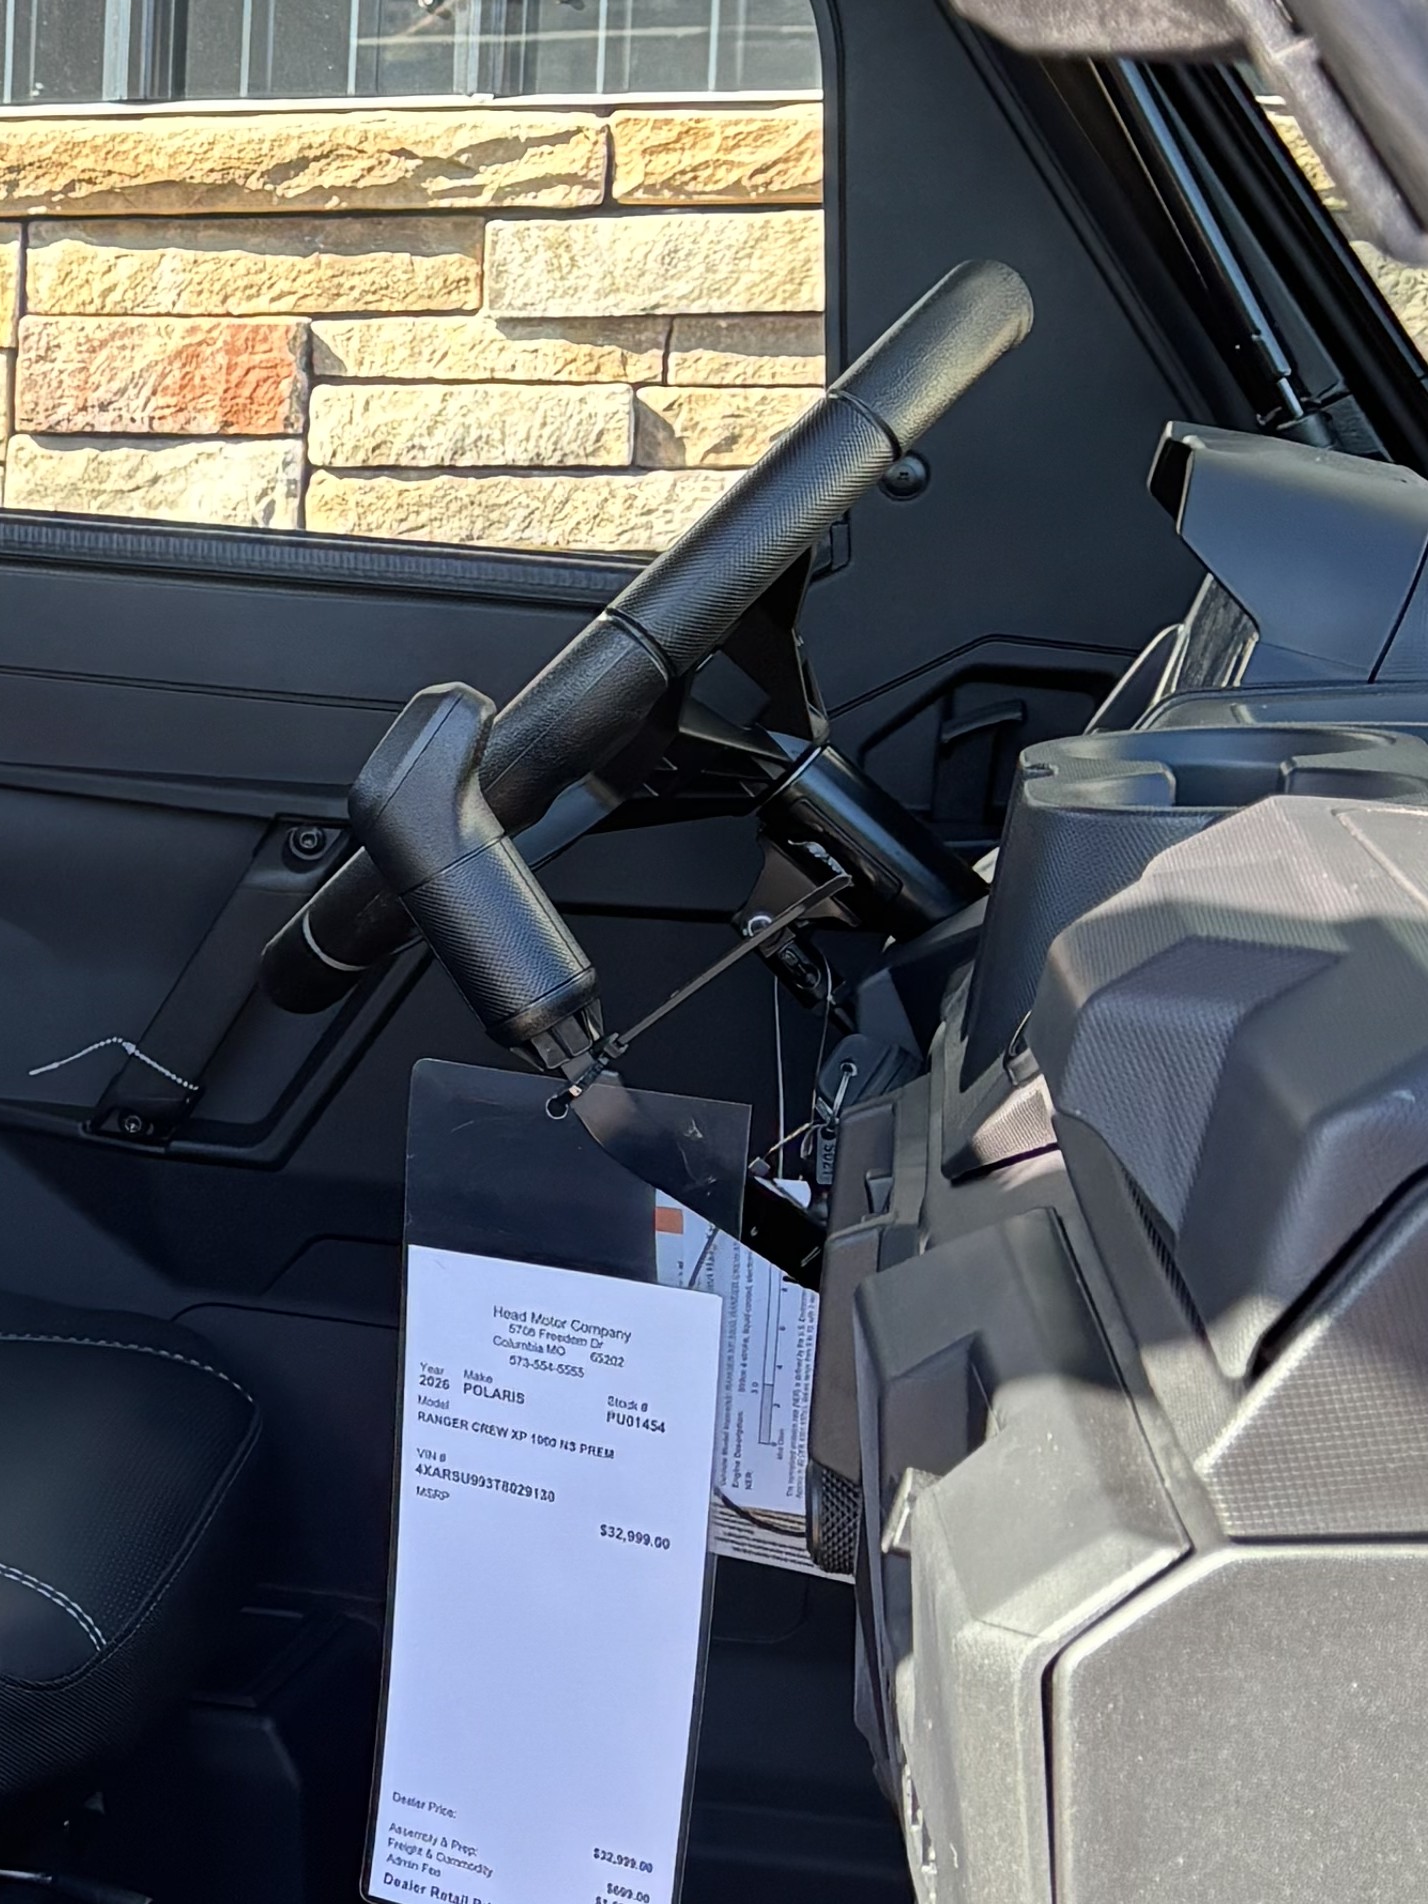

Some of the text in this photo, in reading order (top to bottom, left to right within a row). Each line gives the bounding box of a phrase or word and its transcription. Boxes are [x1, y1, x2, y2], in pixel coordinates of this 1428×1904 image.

[494, 1304, 632, 1344] Head Motor Company
[492, 1334, 625, 1369] Columbia MO 65202
[538, 1328, 588, 1347] Freedom
[590, 1337, 604, 1350] Dr
[419, 1361, 494, 1385] Year Make
[416, 1394, 450, 1411] Model
[418, 1374, 526, 1406] 2026 POLARIS
[607, 1395, 639, 1412] Stock
[606, 1410, 666, 1434] PU01454
[417, 1410, 469, 1432] RANGER
[471, 1420, 509, 1440] CREW
[511, 1428, 528, 1442] XP
[531, 1432, 557, 1449] 1000
[579, 1442, 616, 1460] PREM
[416, 1447, 437, 1462] VIN
[415, 1484, 450, 1501] MSRP
[599, 1523, 671, 1550] $32,999.00
[392, 1791, 457, 1820] Dealer Price:
[386, 1853, 442, 1878] Admin Fee
[387, 1837, 423, 1856] Freight
[435, 1852, 494, 1879] Commodity
[383, 1871, 427, 1896] Dealer
